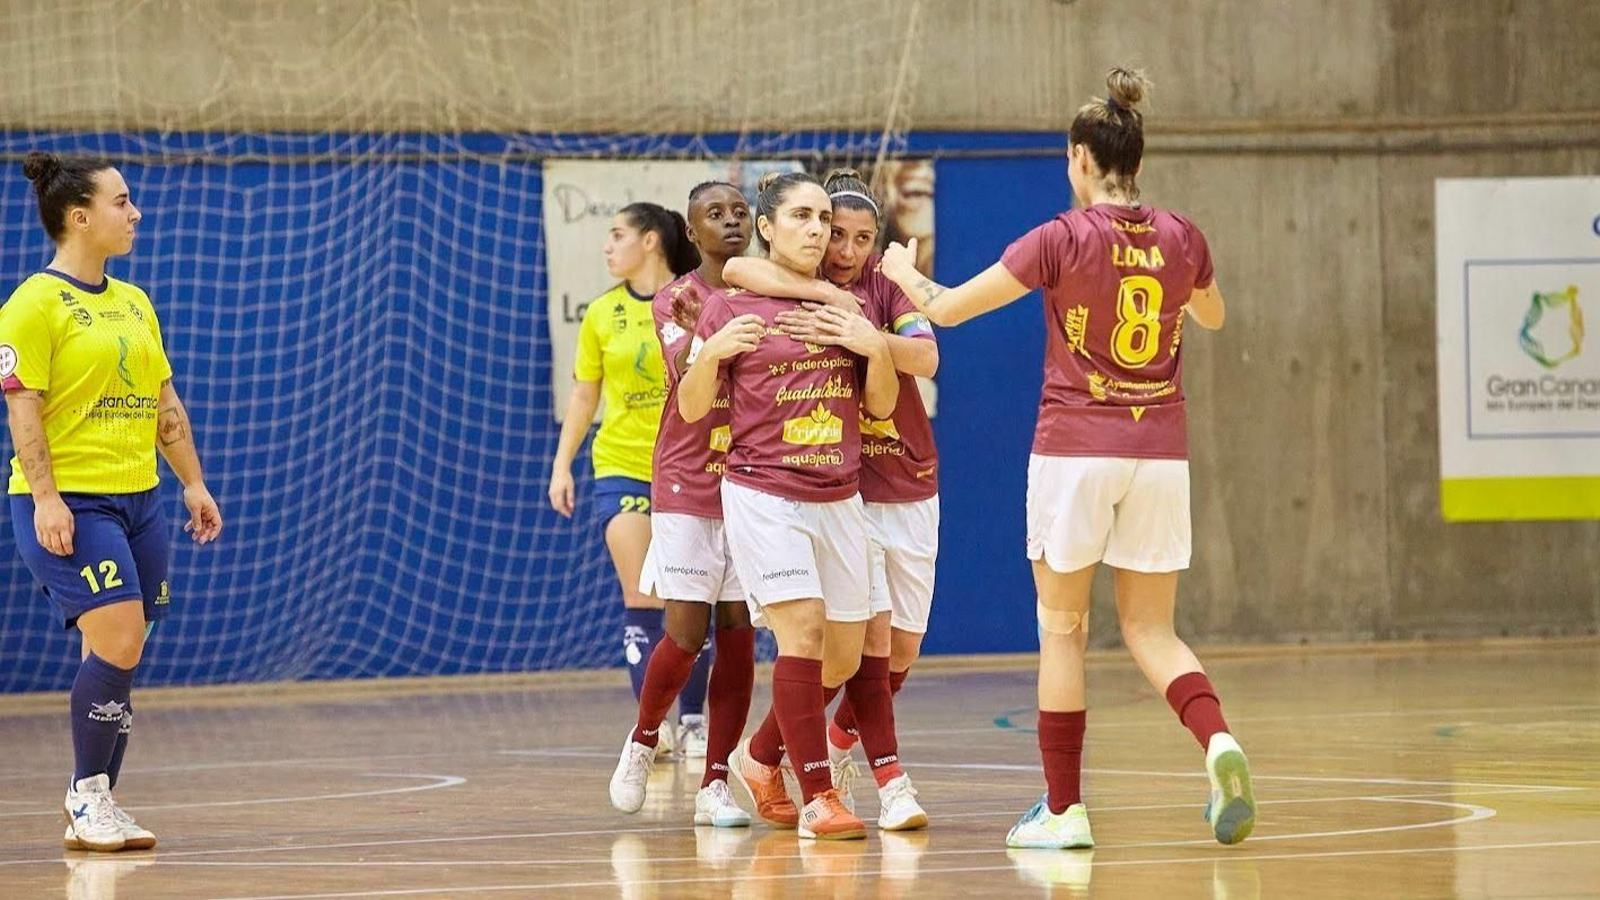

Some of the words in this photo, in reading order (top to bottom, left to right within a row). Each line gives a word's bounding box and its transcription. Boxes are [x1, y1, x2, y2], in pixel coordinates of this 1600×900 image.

[1112, 244, 1165, 268] LORA
[1110, 275, 1163, 369] 8
[80, 560, 123, 594] 12
[762, 568, 810, 581] federópticos
